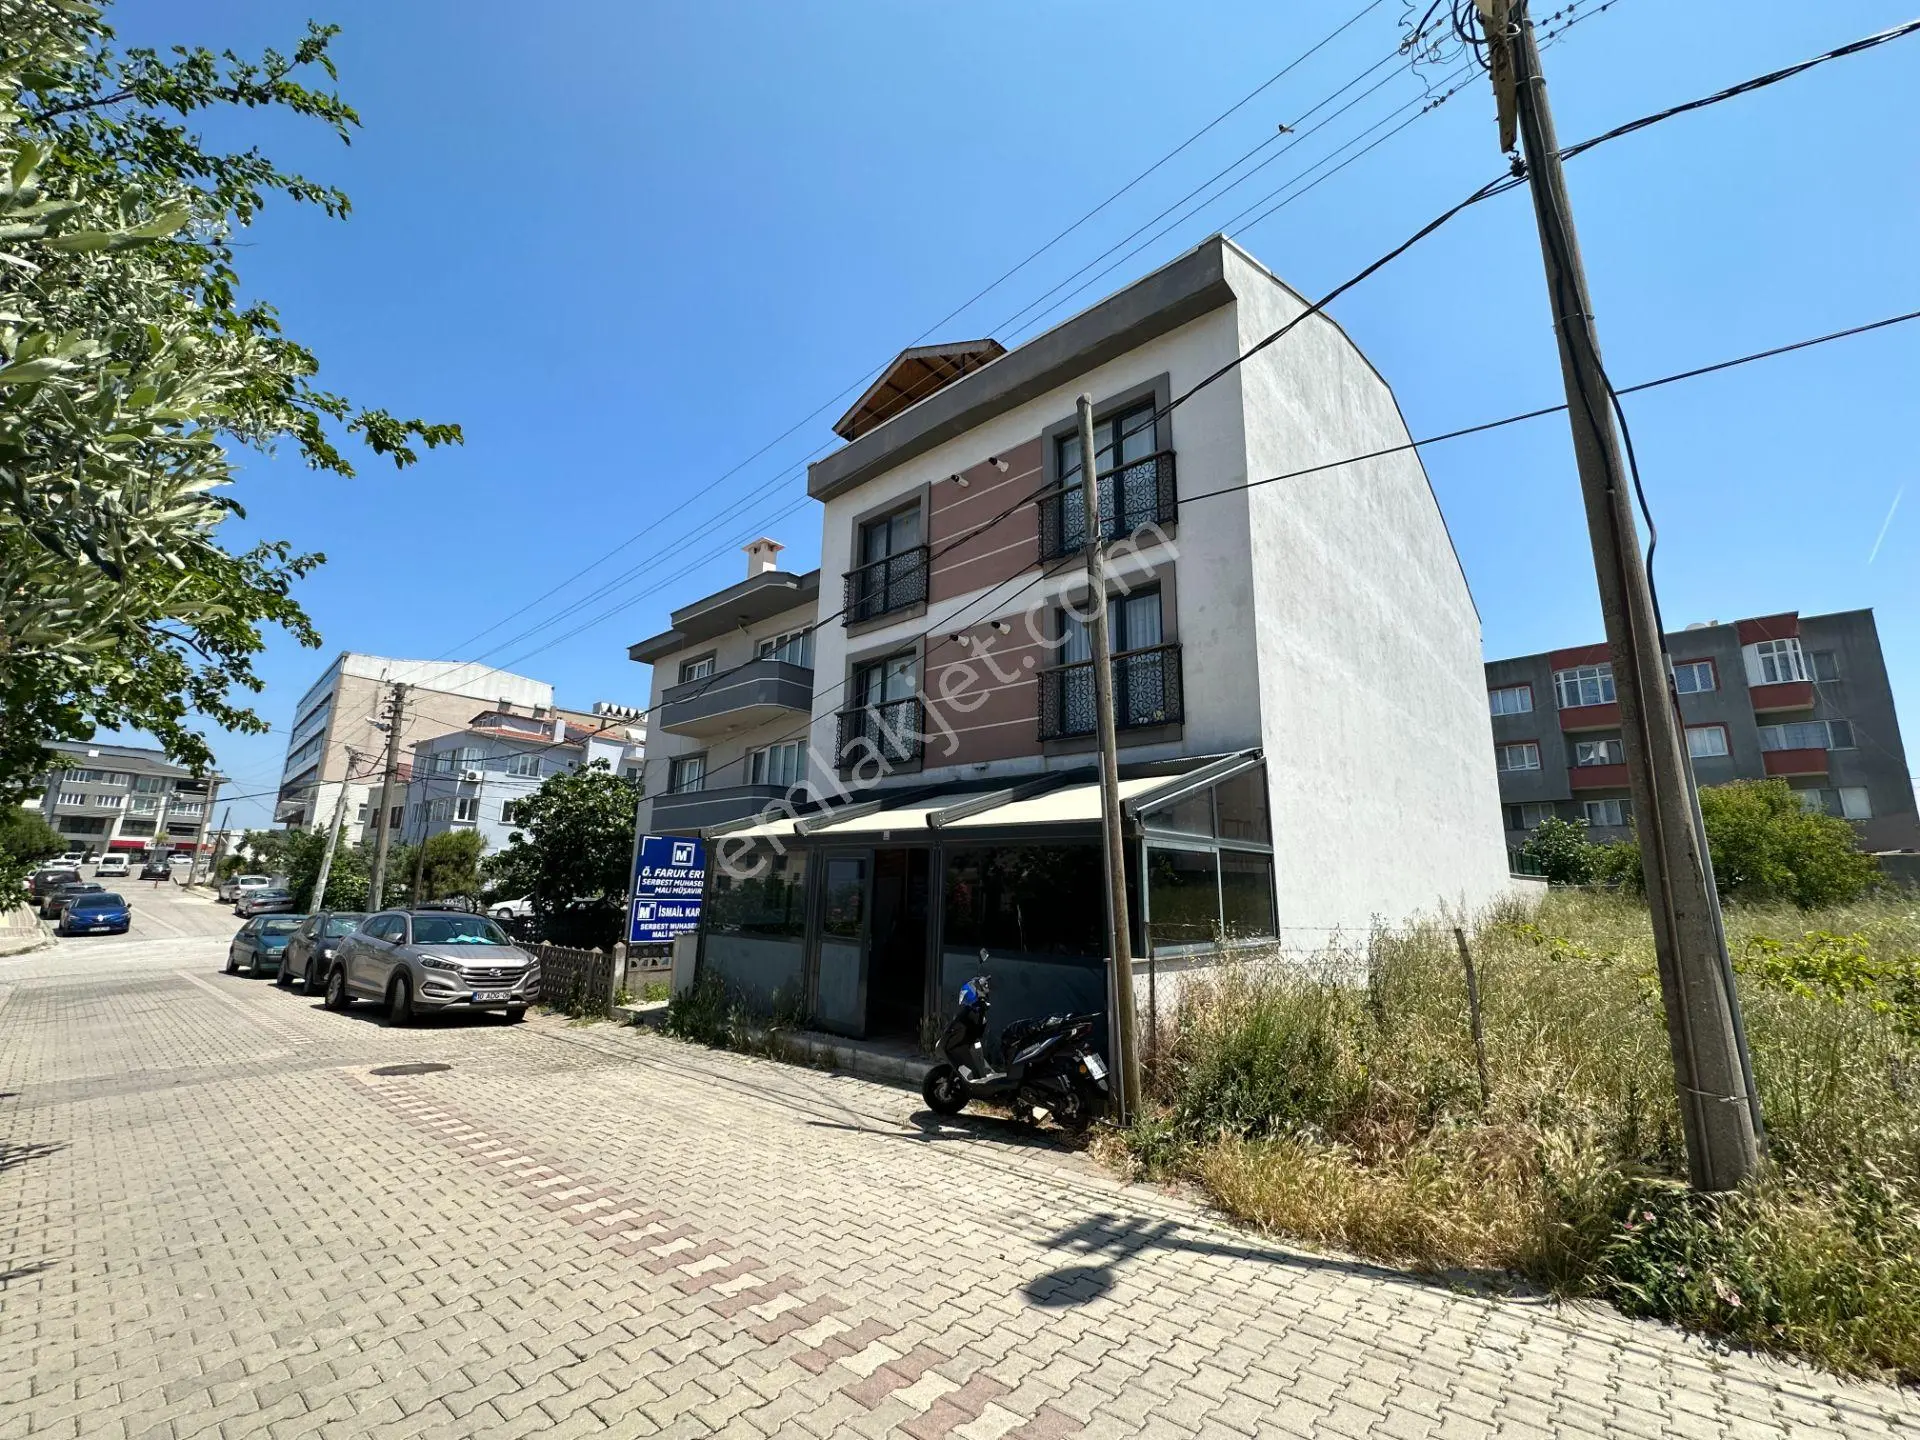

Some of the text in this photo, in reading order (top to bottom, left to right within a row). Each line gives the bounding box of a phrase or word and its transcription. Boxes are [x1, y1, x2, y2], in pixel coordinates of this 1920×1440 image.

[642, 865, 652, 877] Ö.
[654, 868, 688, 878] FARUK
[641, 878, 674, 886] SERBEST
[658, 905, 684, 917] İSMAİL
[669, 922, 700, 930] MUHASE
[652, 930, 668, 938] MALİ
